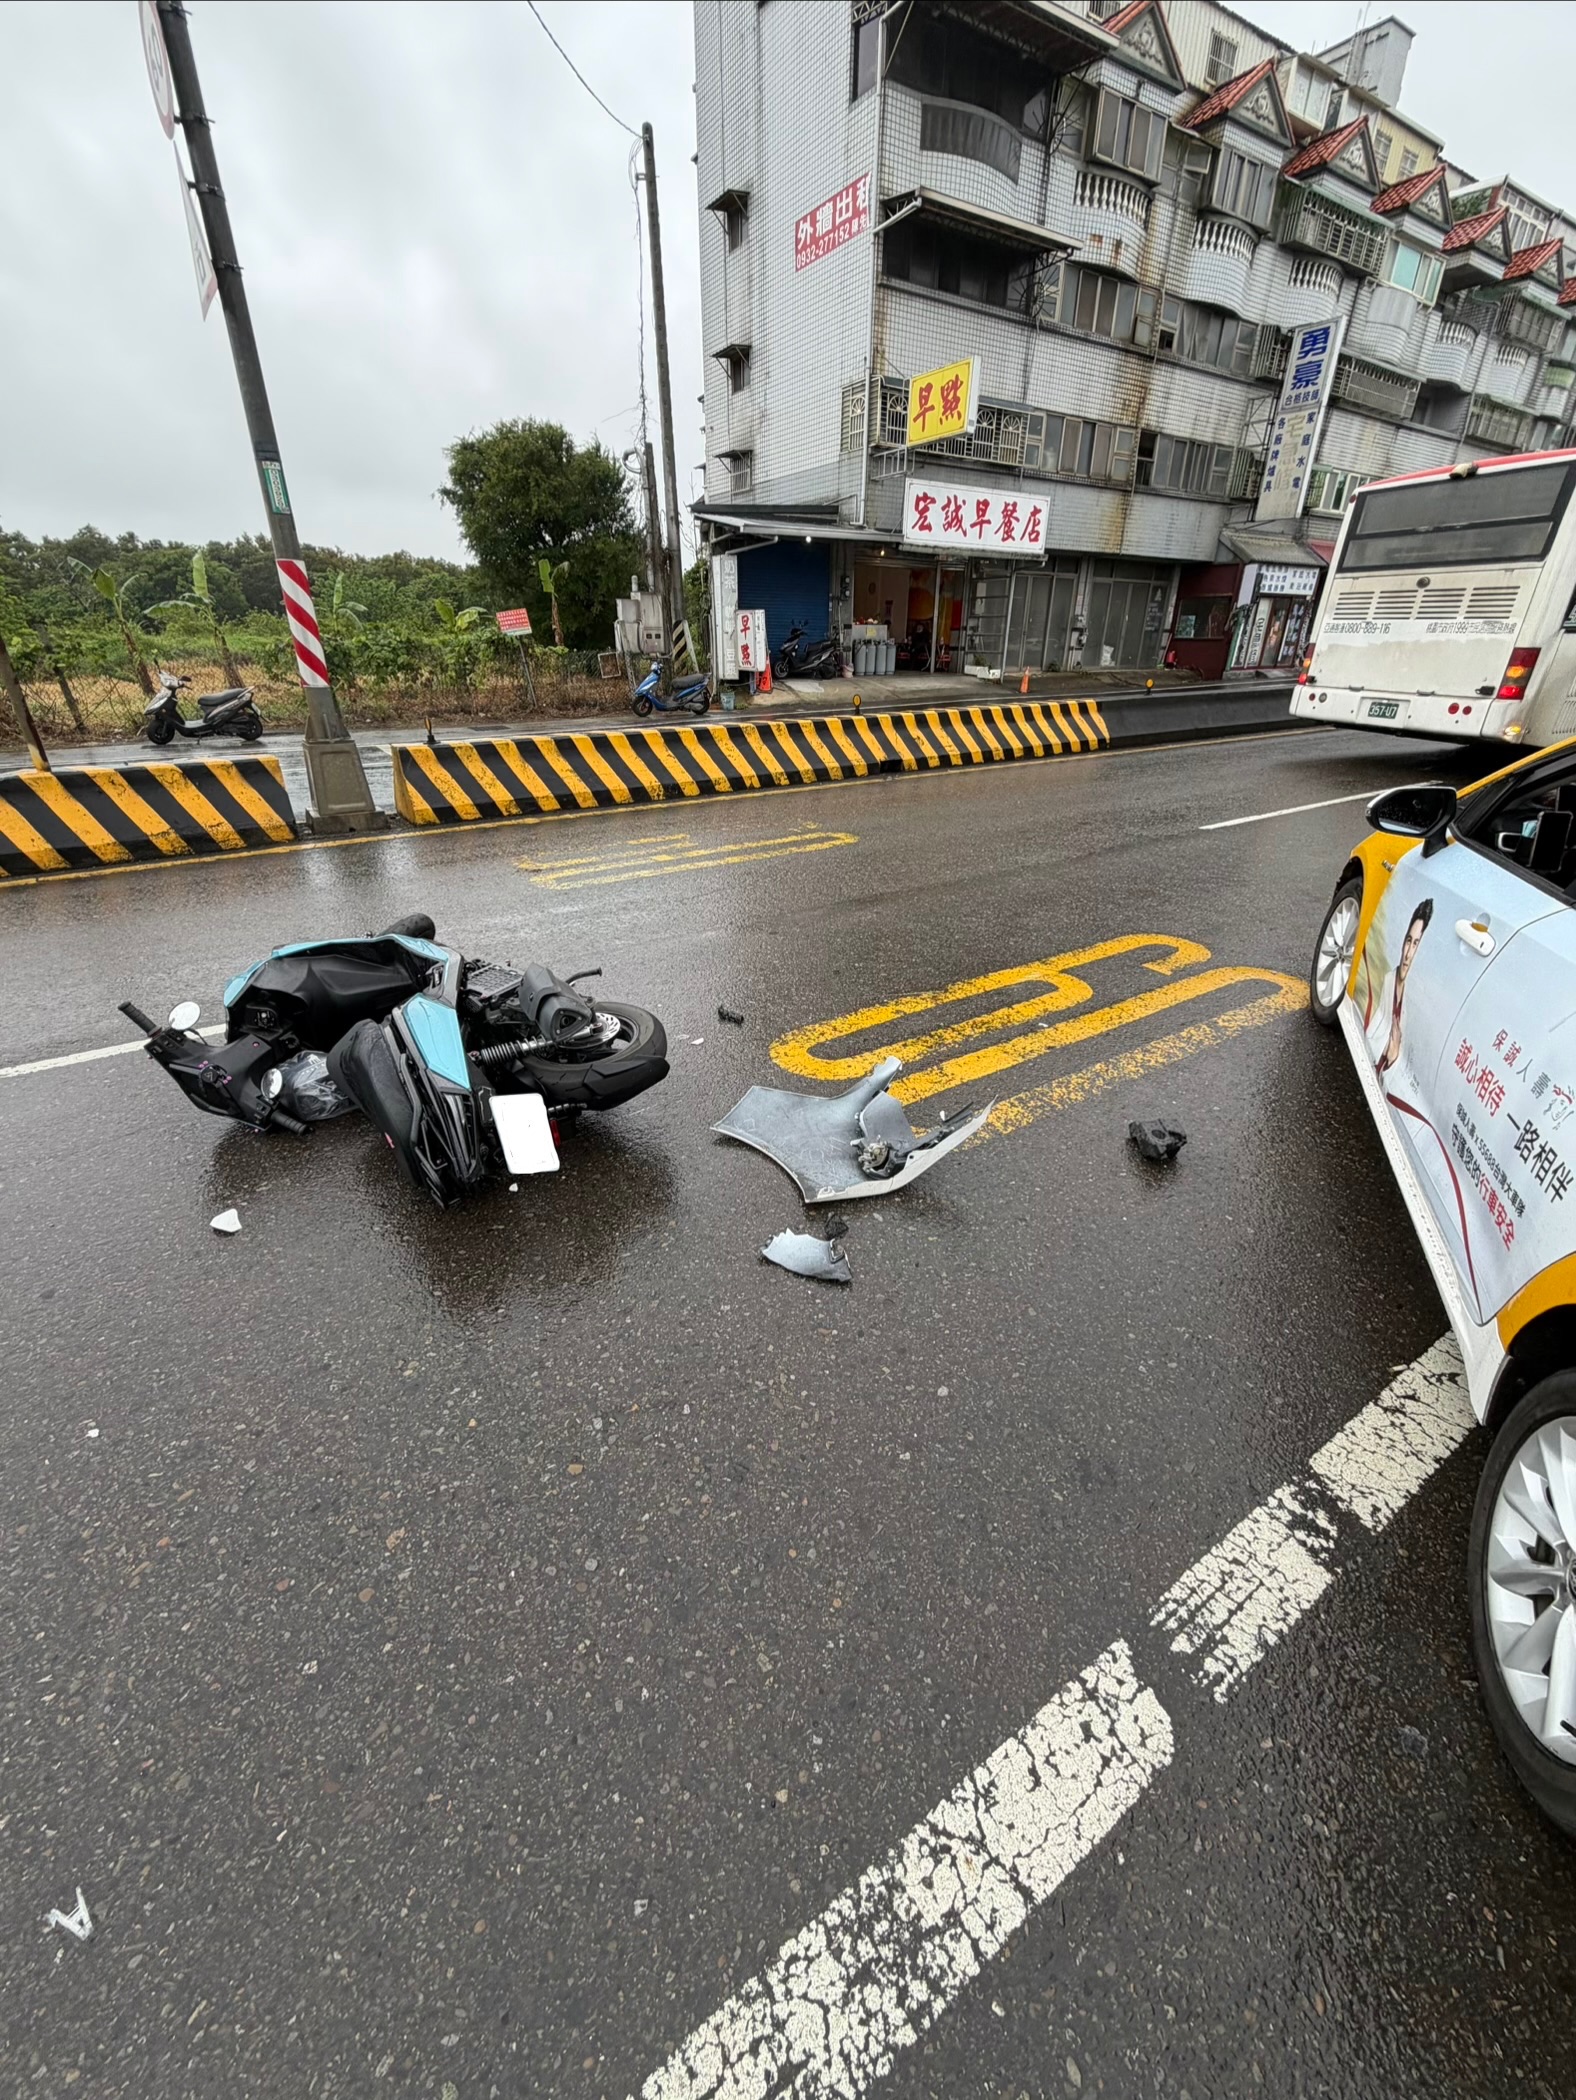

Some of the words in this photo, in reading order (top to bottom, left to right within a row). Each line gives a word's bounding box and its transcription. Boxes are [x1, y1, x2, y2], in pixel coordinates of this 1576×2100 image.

[796, 222, 850, 269] 0932-277152
[1290, 326, 1331, 391] 勇豪
[1292, 412, 1317, 490] 家庭水電
[911, 491, 1043, 543] 宏誠早餐店
[1369, 704, 1398, 718] 357-U7
[1492, 1029, 1551, 1099] 保誠人壽
[1454, 1037, 1506, 1117] 誠心相待
[1506, 1112, 1575, 1203] 一路相伴
[1451, 1123, 1516, 1251] 守護您的行車安全
